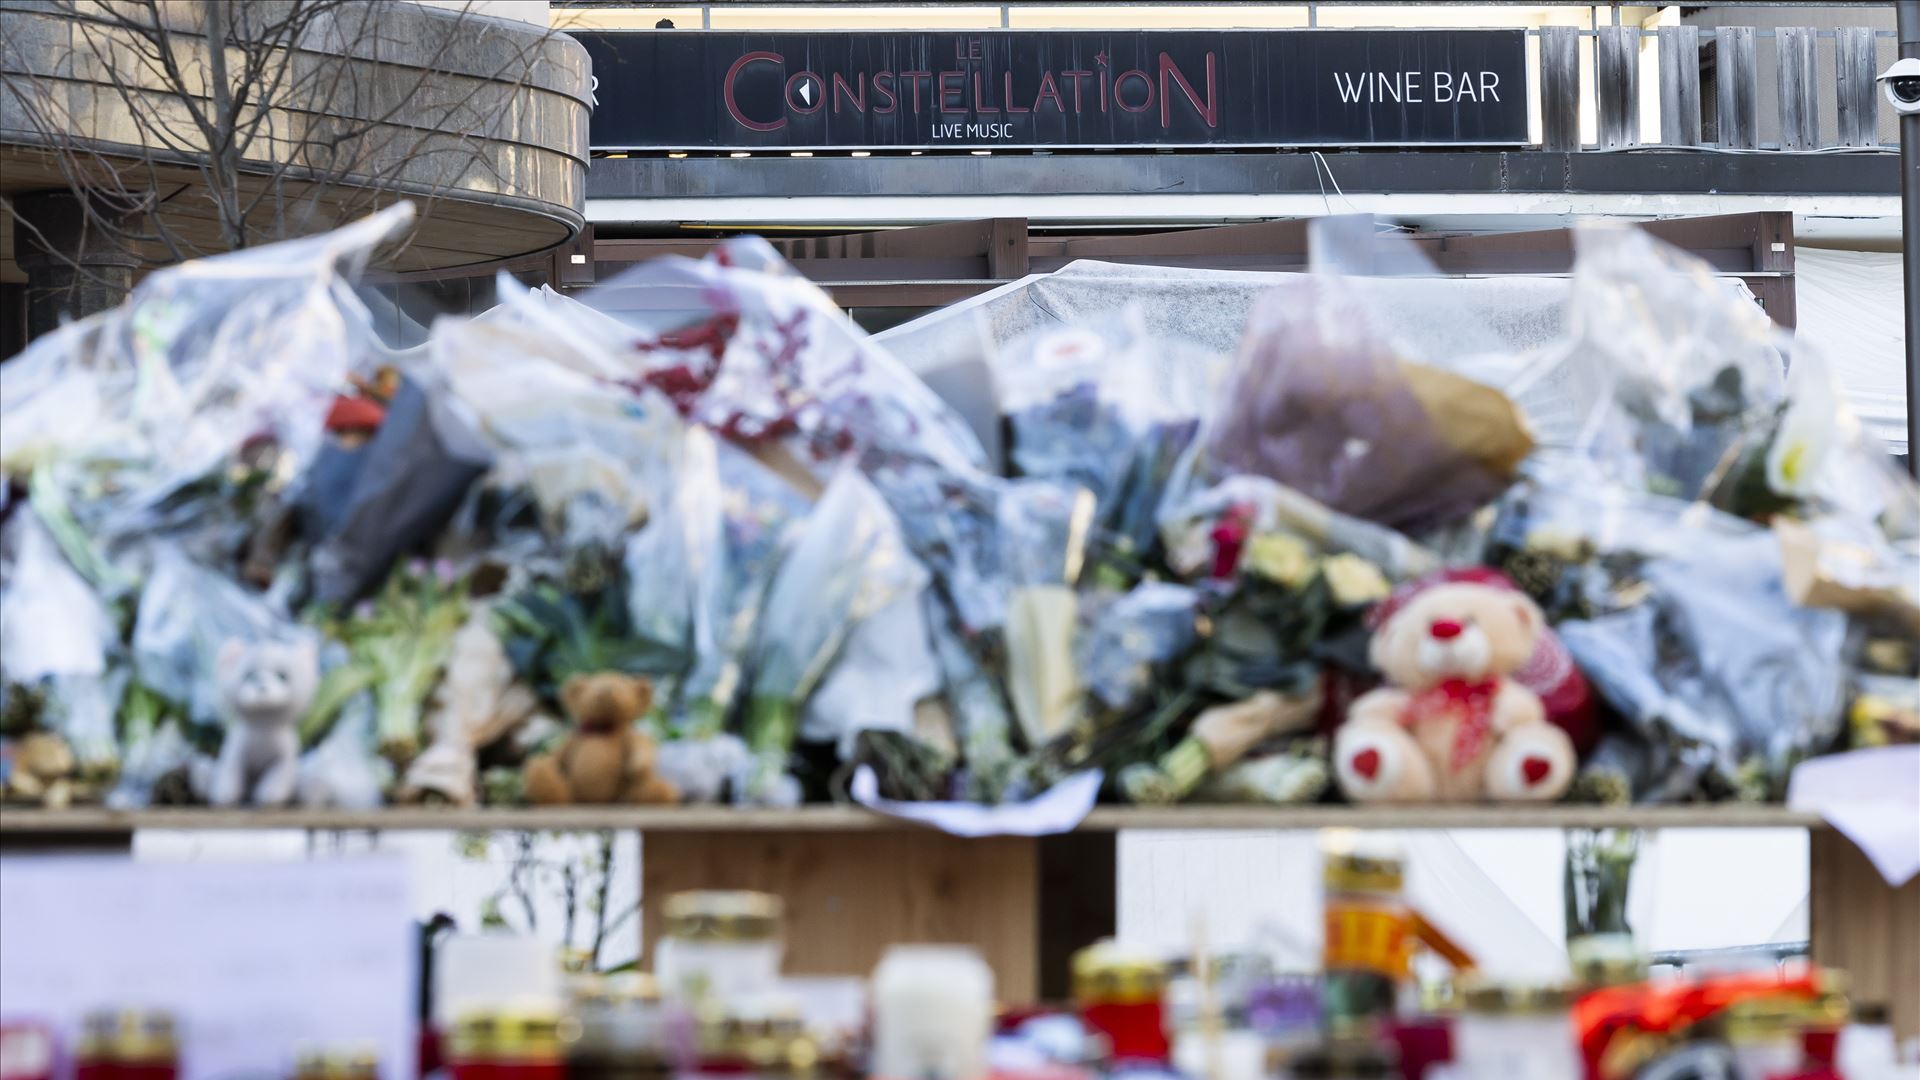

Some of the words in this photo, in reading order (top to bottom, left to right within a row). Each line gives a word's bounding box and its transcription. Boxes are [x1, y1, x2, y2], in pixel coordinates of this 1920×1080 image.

[956, 38, 982, 60] LE
[1333, 72, 1422, 103] WINE
[1433, 72, 1500, 103] BAR
[932, 123, 962, 139] LIVE
[966, 123, 1013, 139] MUSIC
